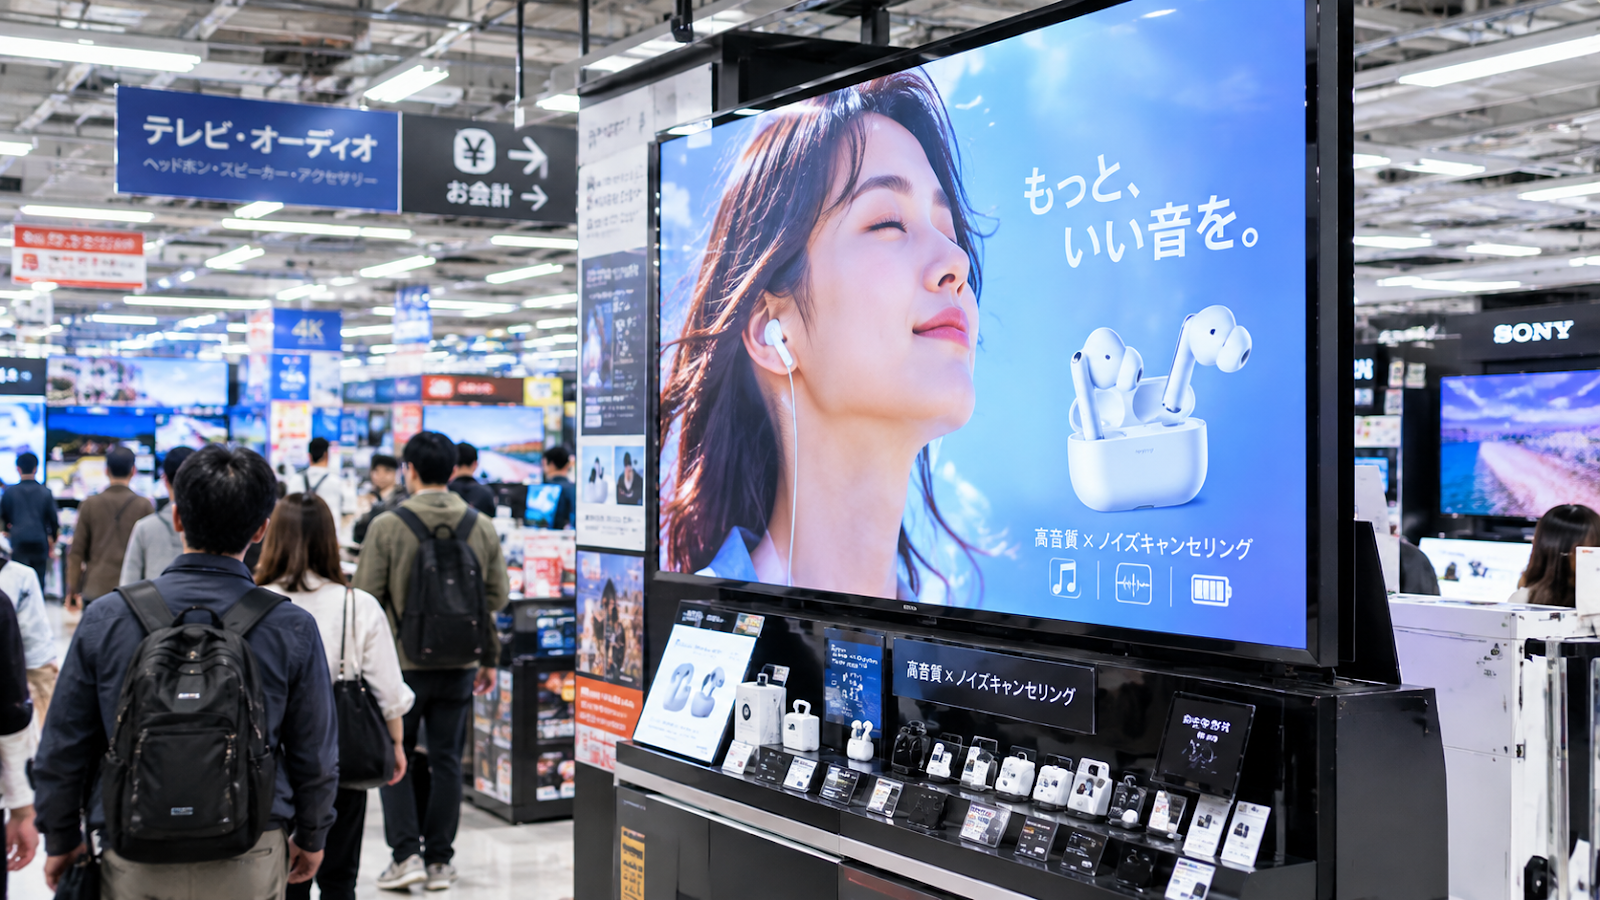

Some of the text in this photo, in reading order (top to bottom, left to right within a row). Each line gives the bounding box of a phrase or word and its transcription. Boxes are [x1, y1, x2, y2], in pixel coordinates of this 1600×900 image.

[143, 114, 378, 163] テレビ・オーディオ
[143, 157, 378, 187] ヘッドホン・スピーカー・アクセサリー
[1023, 154, 1141, 216] もっと、
[446, 179, 513, 208] お会計
[1064, 194, 1259, 269] いい音を。
[291, 318, 325, 341] 4K
[1493, 319, 1575, 344] SONY
[1098, 531, 1254, 561] ノイズキャンセリング
[956, 669, 1077, 706] ノイズキャンセリング
